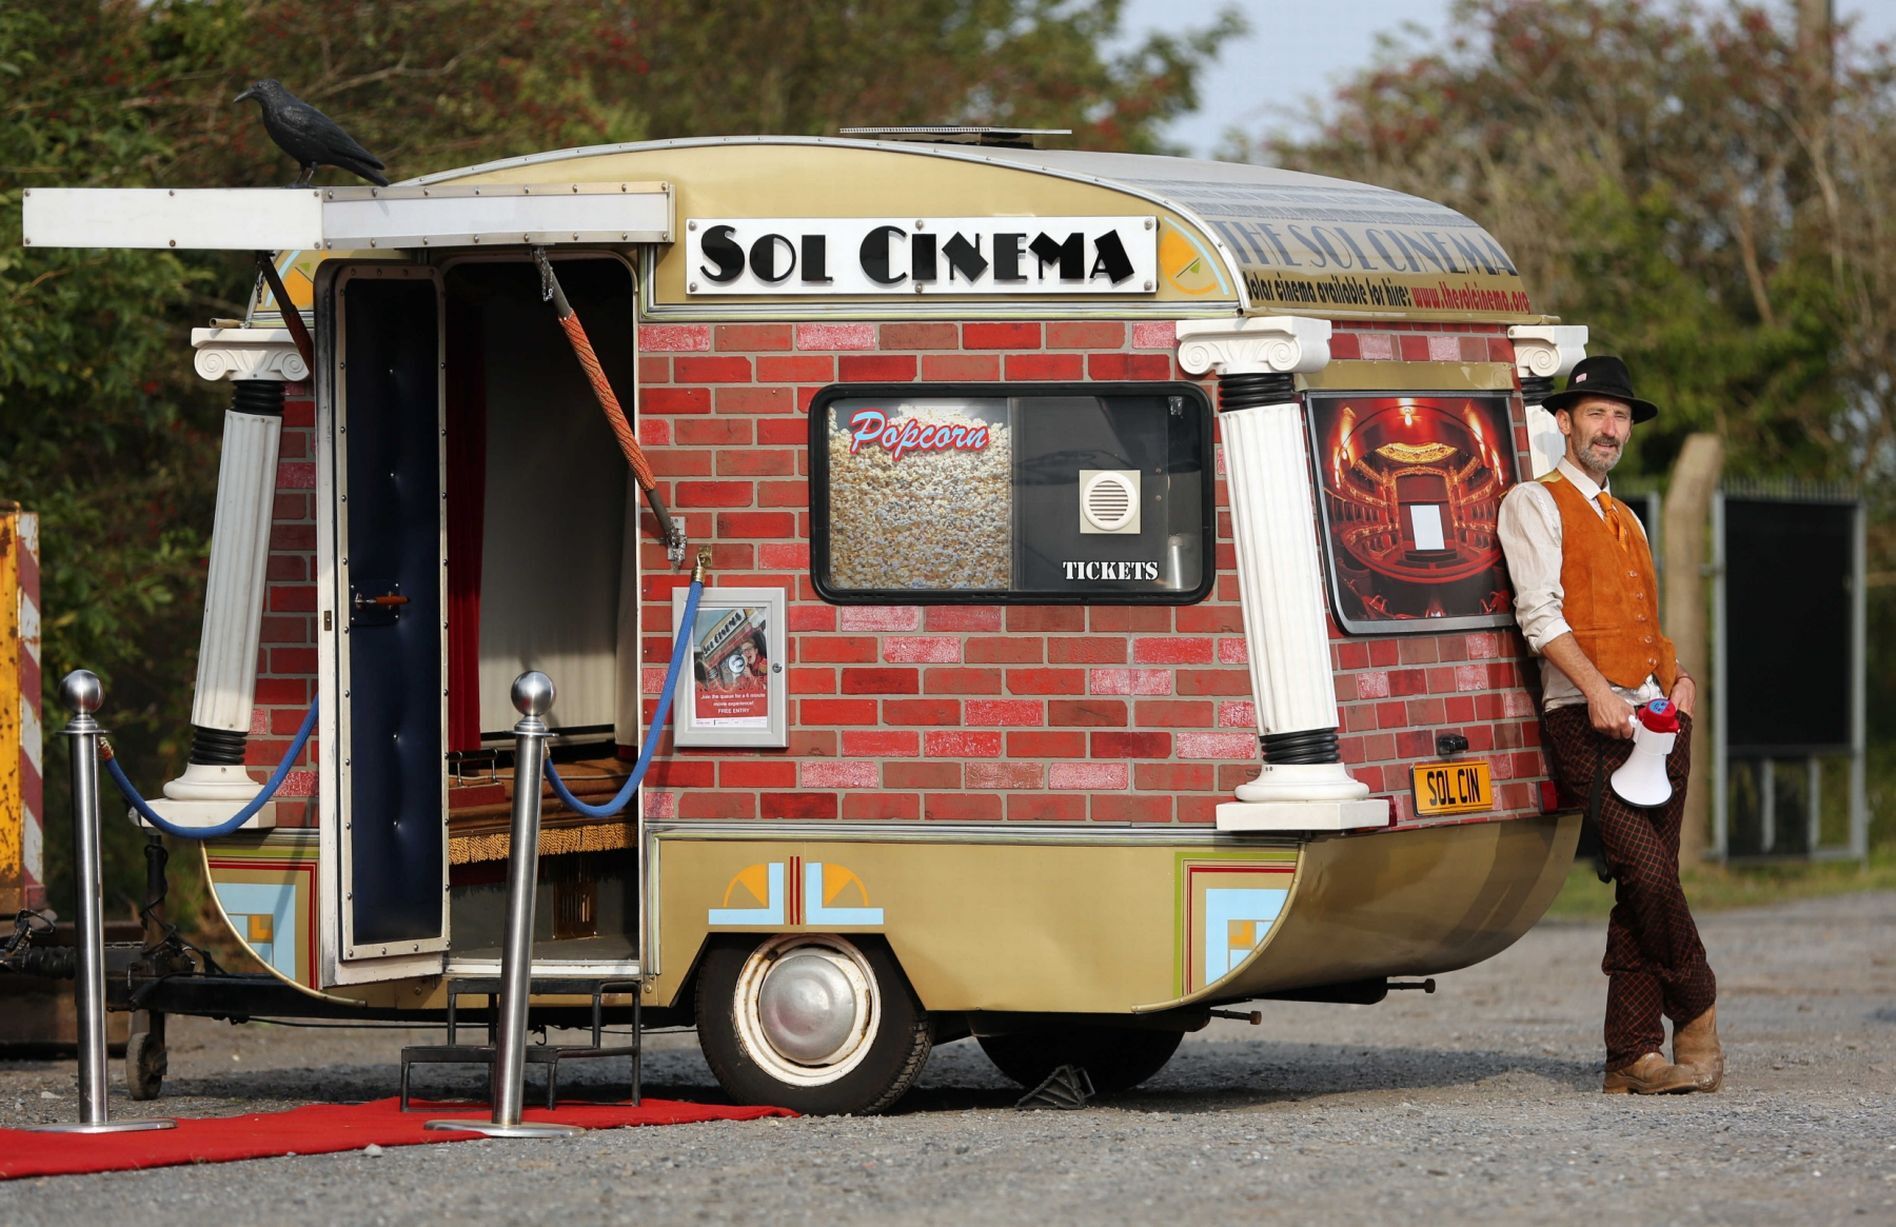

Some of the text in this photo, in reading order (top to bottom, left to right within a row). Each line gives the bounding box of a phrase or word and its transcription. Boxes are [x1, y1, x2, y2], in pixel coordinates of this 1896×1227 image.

[699, 224, 1136, 284] SOL CINEMA
[1288, 224, 1379, 271] SOL
[1366, 229, 1520, 277] CINEMA
[1273, 272, 1318, 303] cinema
[1316, 273, 1369, 305] available
[1365, 277, 1387, 306] for
[849, 408, 990, 461] Popcorn
[1062, 561, 1159, 581] TICKETS
[1426, 768, 1481, 806] SOL CIN
